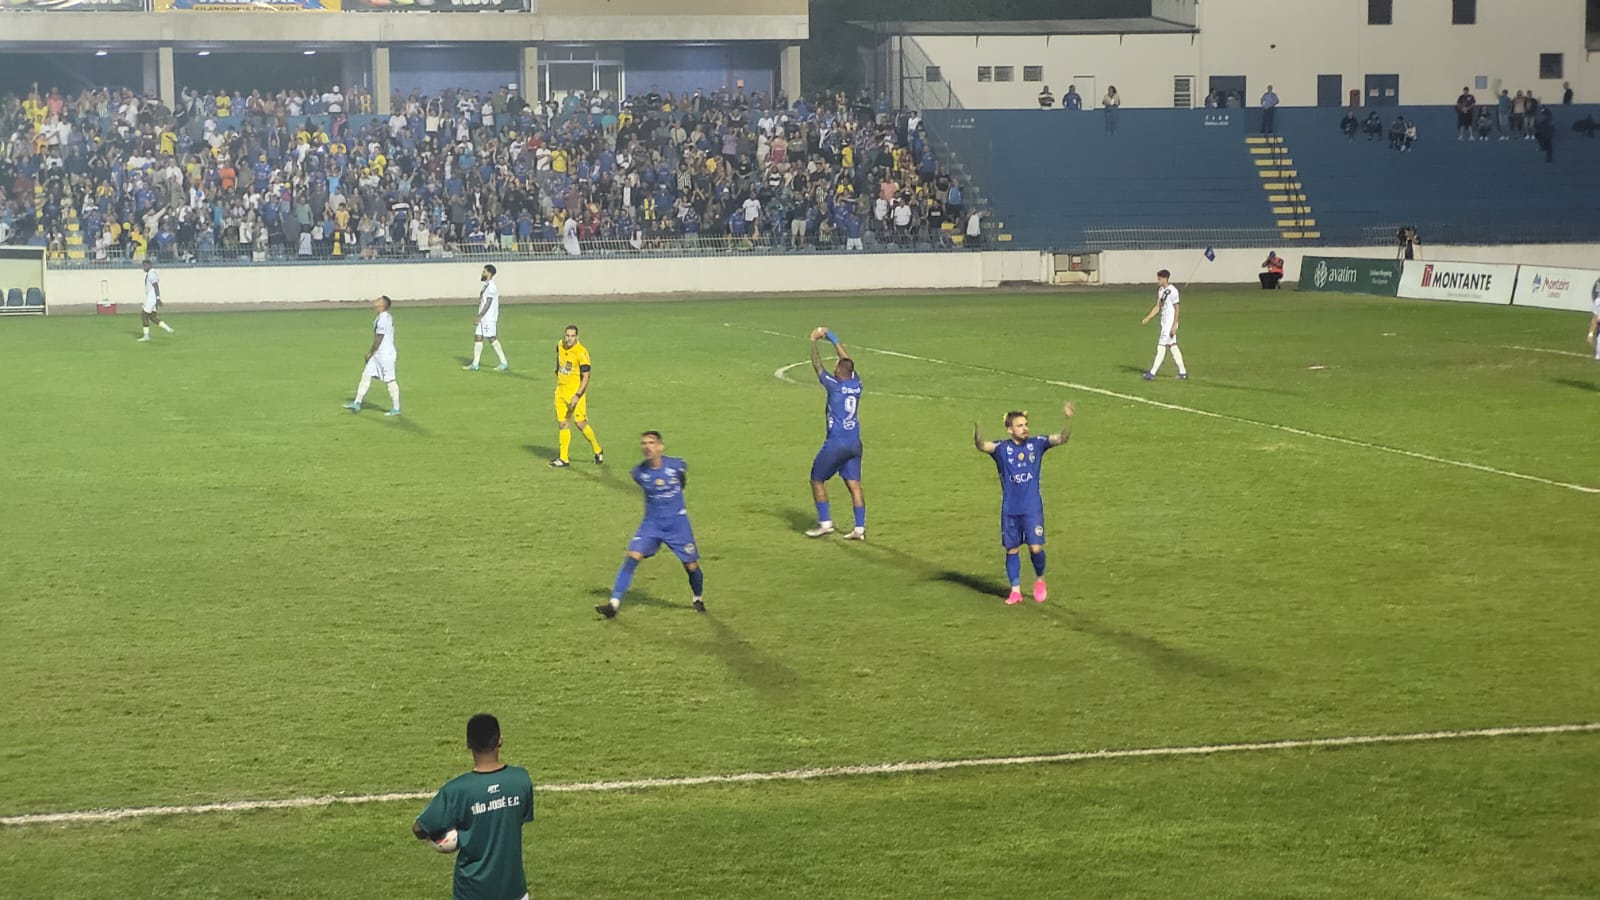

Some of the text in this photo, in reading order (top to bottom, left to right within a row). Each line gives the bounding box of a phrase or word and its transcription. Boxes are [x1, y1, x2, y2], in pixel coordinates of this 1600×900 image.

[1329, 266, 1357, 283] avatim
[1432, 271, 1492, 291] MONTANTE
[844, 395, 857, 420] 9
[471, 802, 486, 815] SÃO
[487, 795, 507, 811] JOSÉ
